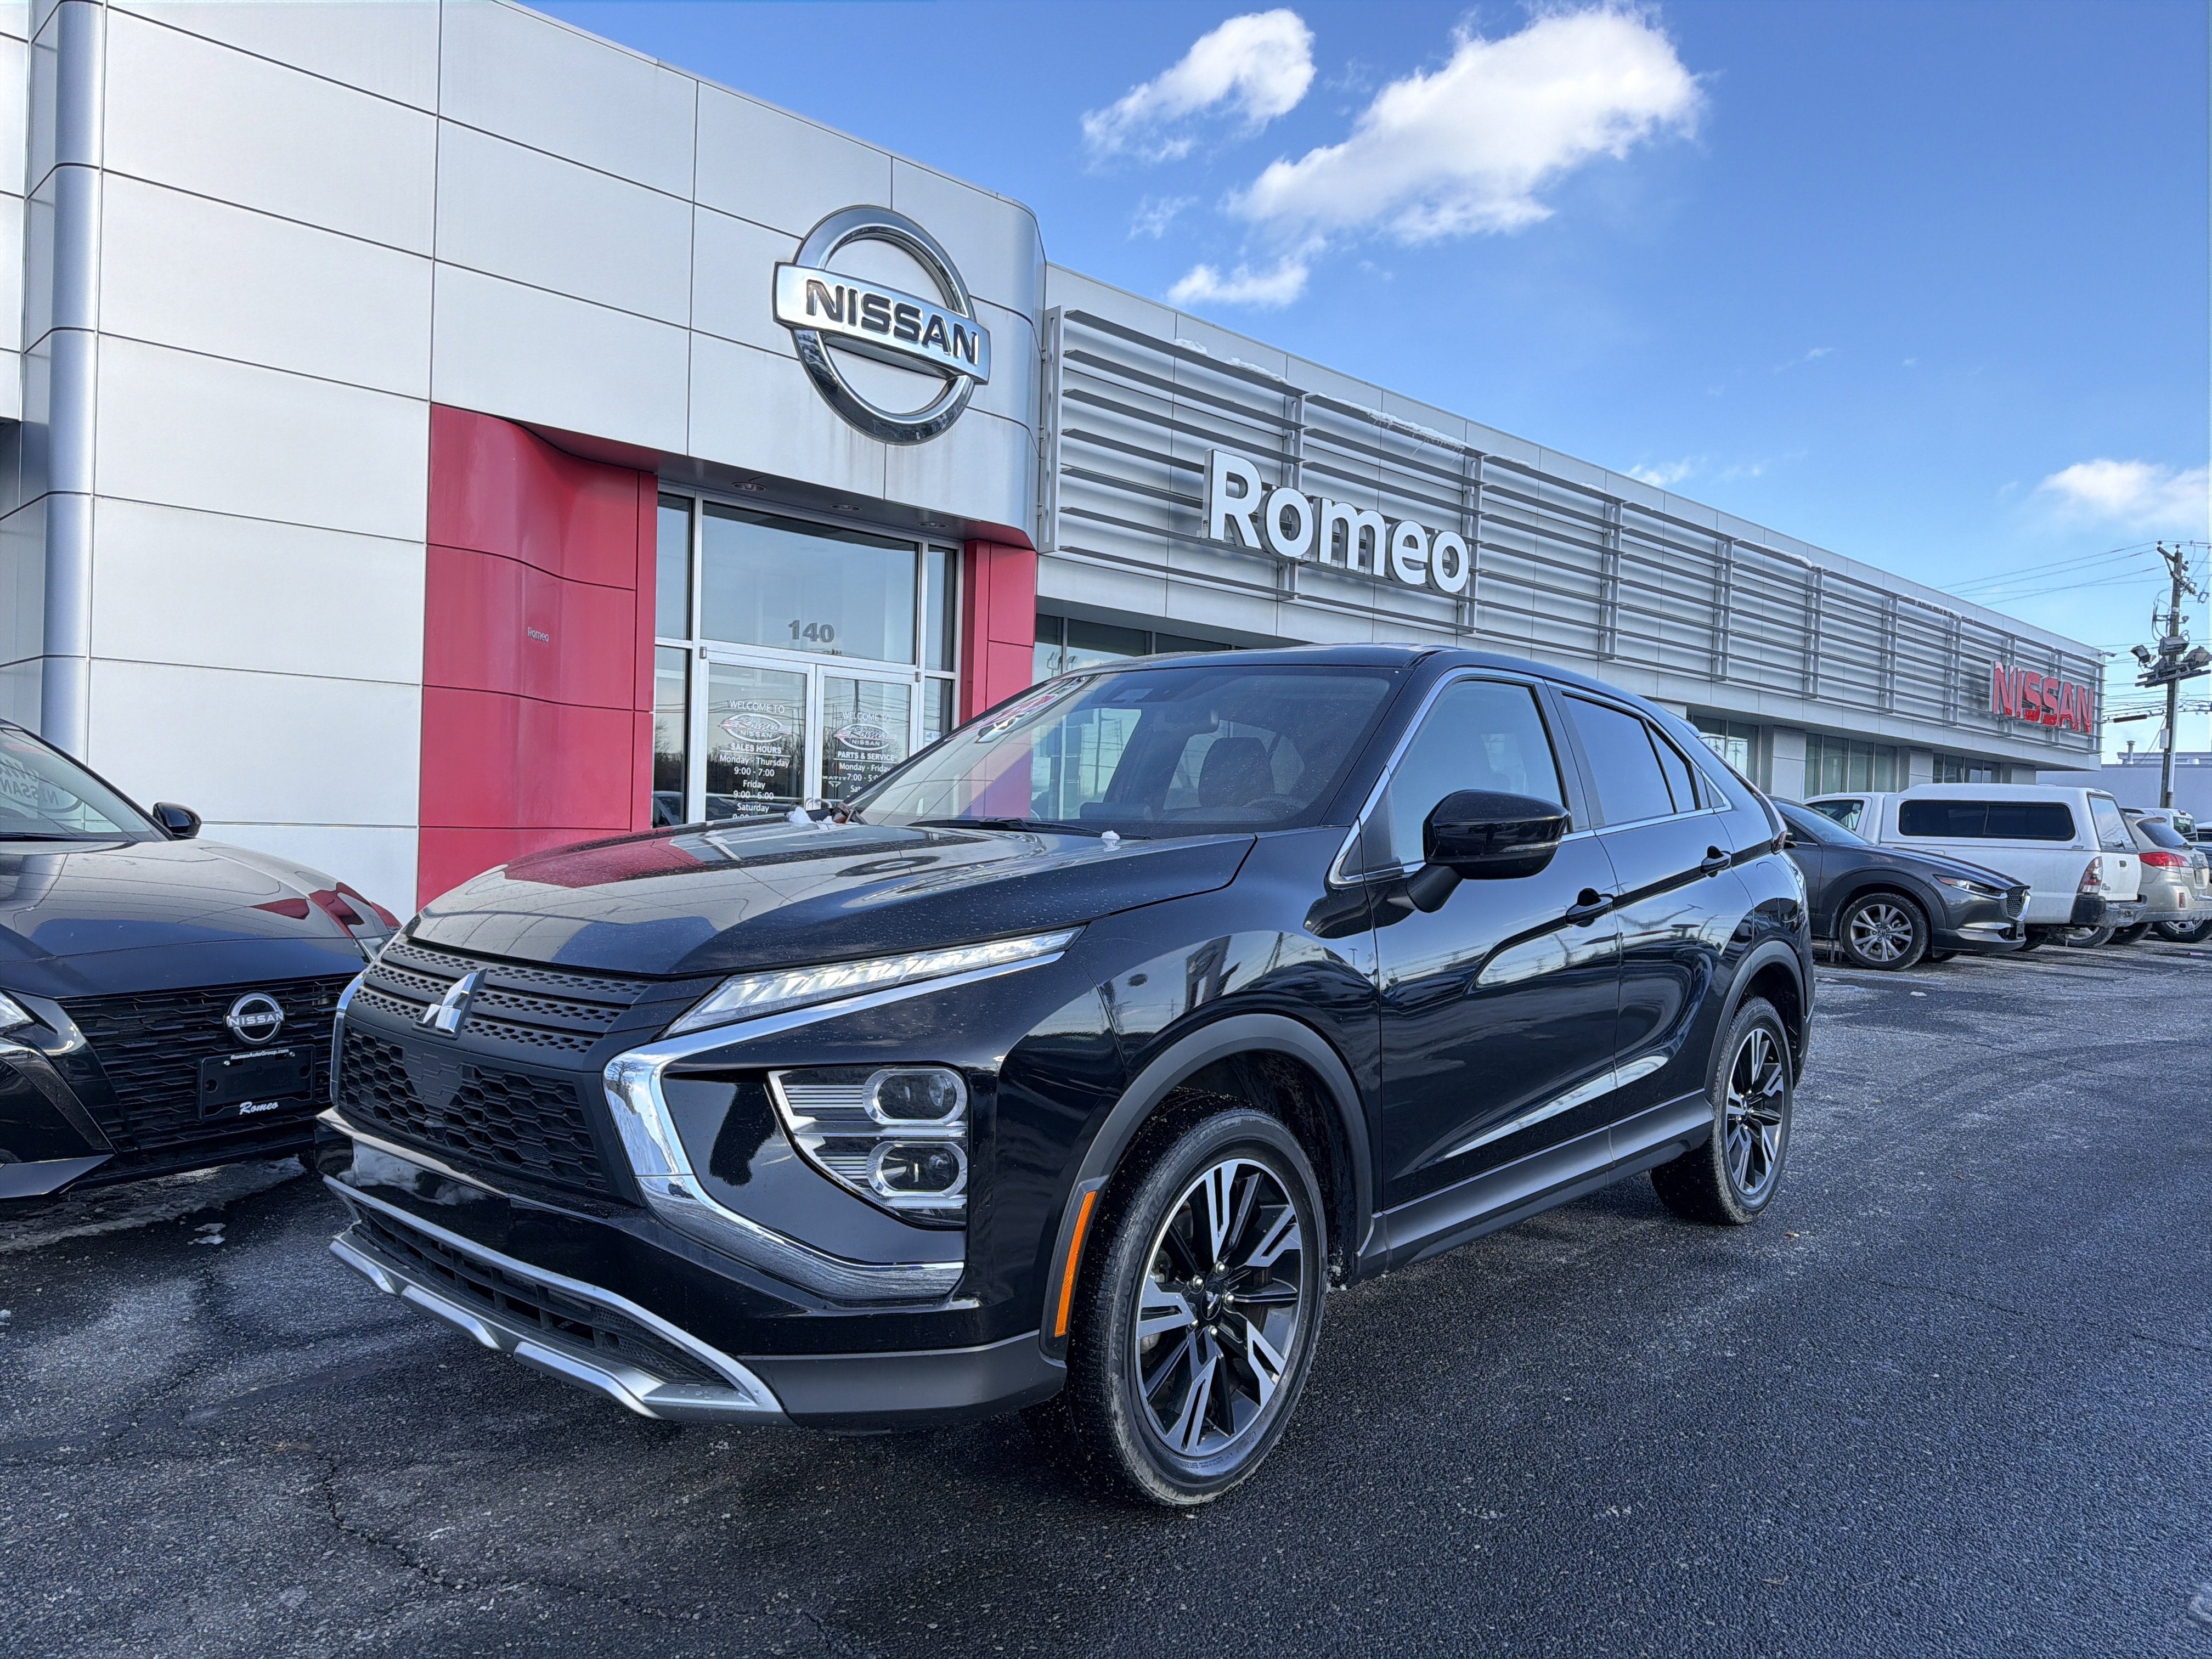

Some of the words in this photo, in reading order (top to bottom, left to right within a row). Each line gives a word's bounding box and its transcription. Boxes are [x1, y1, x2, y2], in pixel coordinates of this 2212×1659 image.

[805, 279, 979, 366] NISSAN
[1205, 449, 1469, 592] Romeo
[527, 627, 549, 642] Romeo
[788, 619, 834, 642] 140
[1991, 661, 2094, 734] NISSAN
[730, 699, 771, 713] WELCOME
[774, 705, 785, 713] TO
[737, 715, 781, 731] Romeo
[842, 711, 878, 722] WELCOME
[882, 714, 891, 723] TO
[847, 725, 888, 740] Romeo
[731, 743, 754, 752] SALES
[757, 745, 782, 754] HOURS
[838, 751, 859, 759] PARTS
[720, 754, 749, 765] Monday
[757, 757, 790, 768] Thursday
[839, 763, 866, 773] Monday
[734, 766, 751, 775] 9:00
[758, 768, 775, 777] 7:00
[743, 780, 766, 790] Friday
[733, 790, 751, 799] 9:00
[757, 792, 774, 800] 6:00
[737, 803, 770, 812] Saturday
[228, 1010, 284, 1026] NISSAN
[231, 1049, 289, 1060] RomeoAutoGroup.com
[239, 1101, 279, 1115] Romeo
